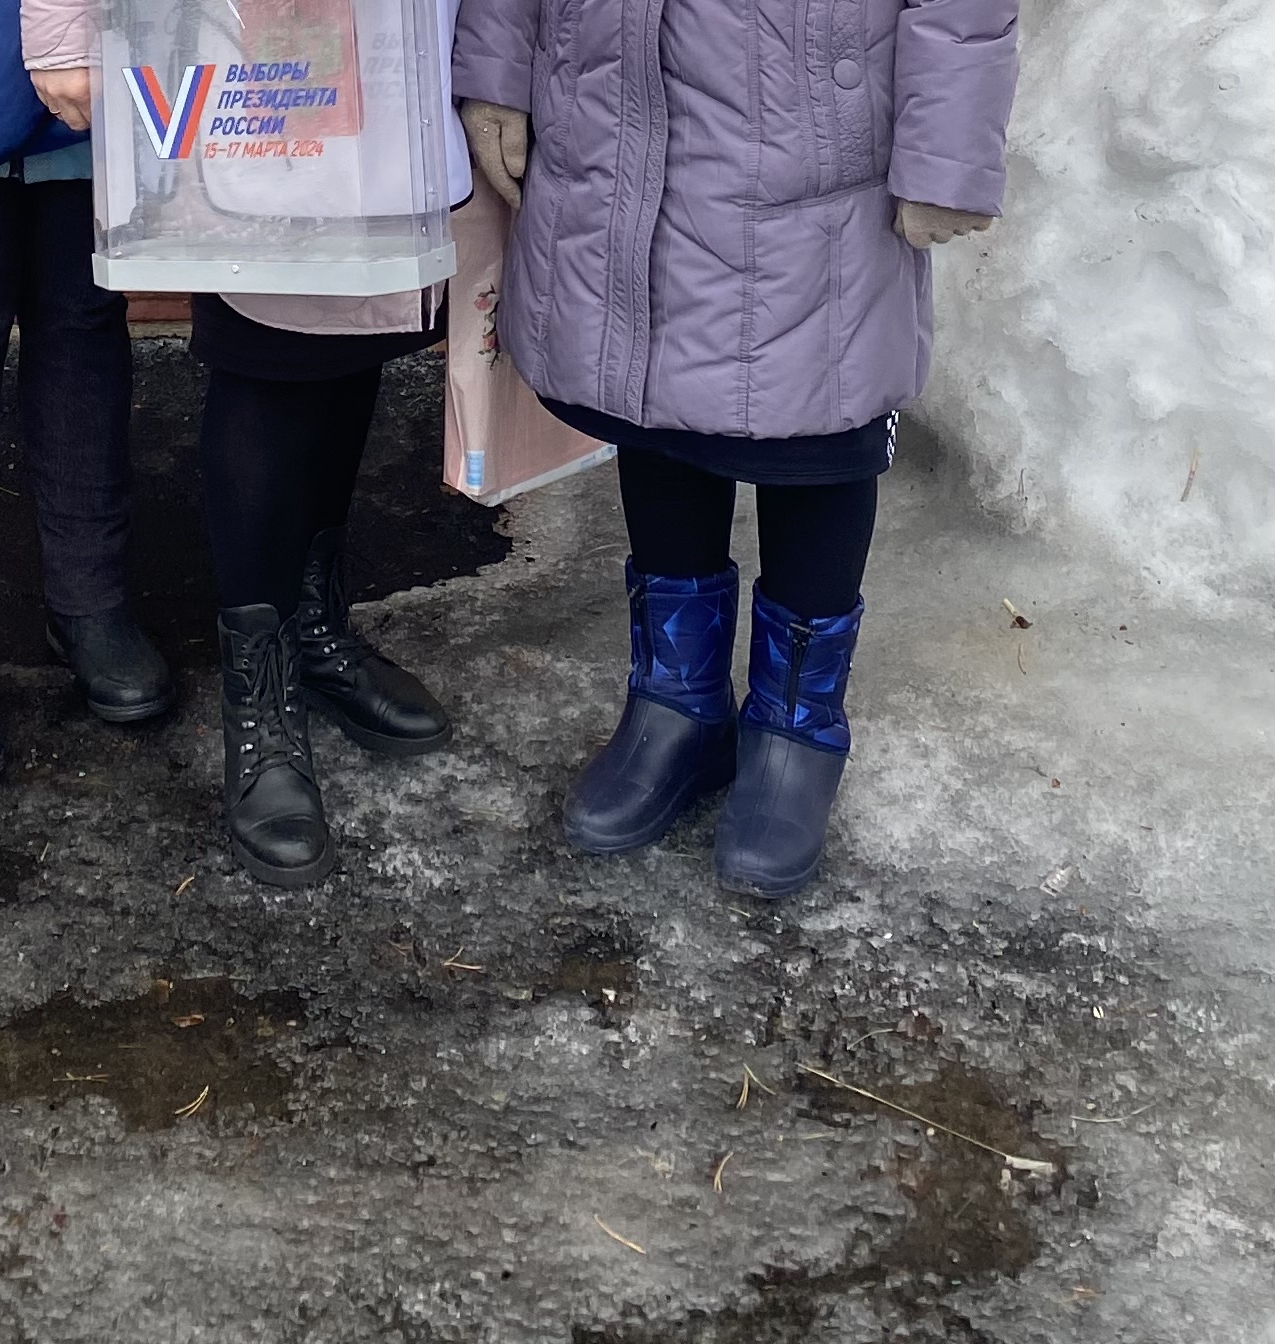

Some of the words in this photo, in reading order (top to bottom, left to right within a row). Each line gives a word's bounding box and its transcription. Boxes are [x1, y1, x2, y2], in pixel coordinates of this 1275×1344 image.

[224, 61, 311, 83] ВЫБОРЫ
[217, 87, 338, 110] ПРЕЗИДЕНТА
[210, 115, 286, 136] РОССИИ
[242, 140, 288, 158] МАРТА
[290, 139, 324, 157] 2024
